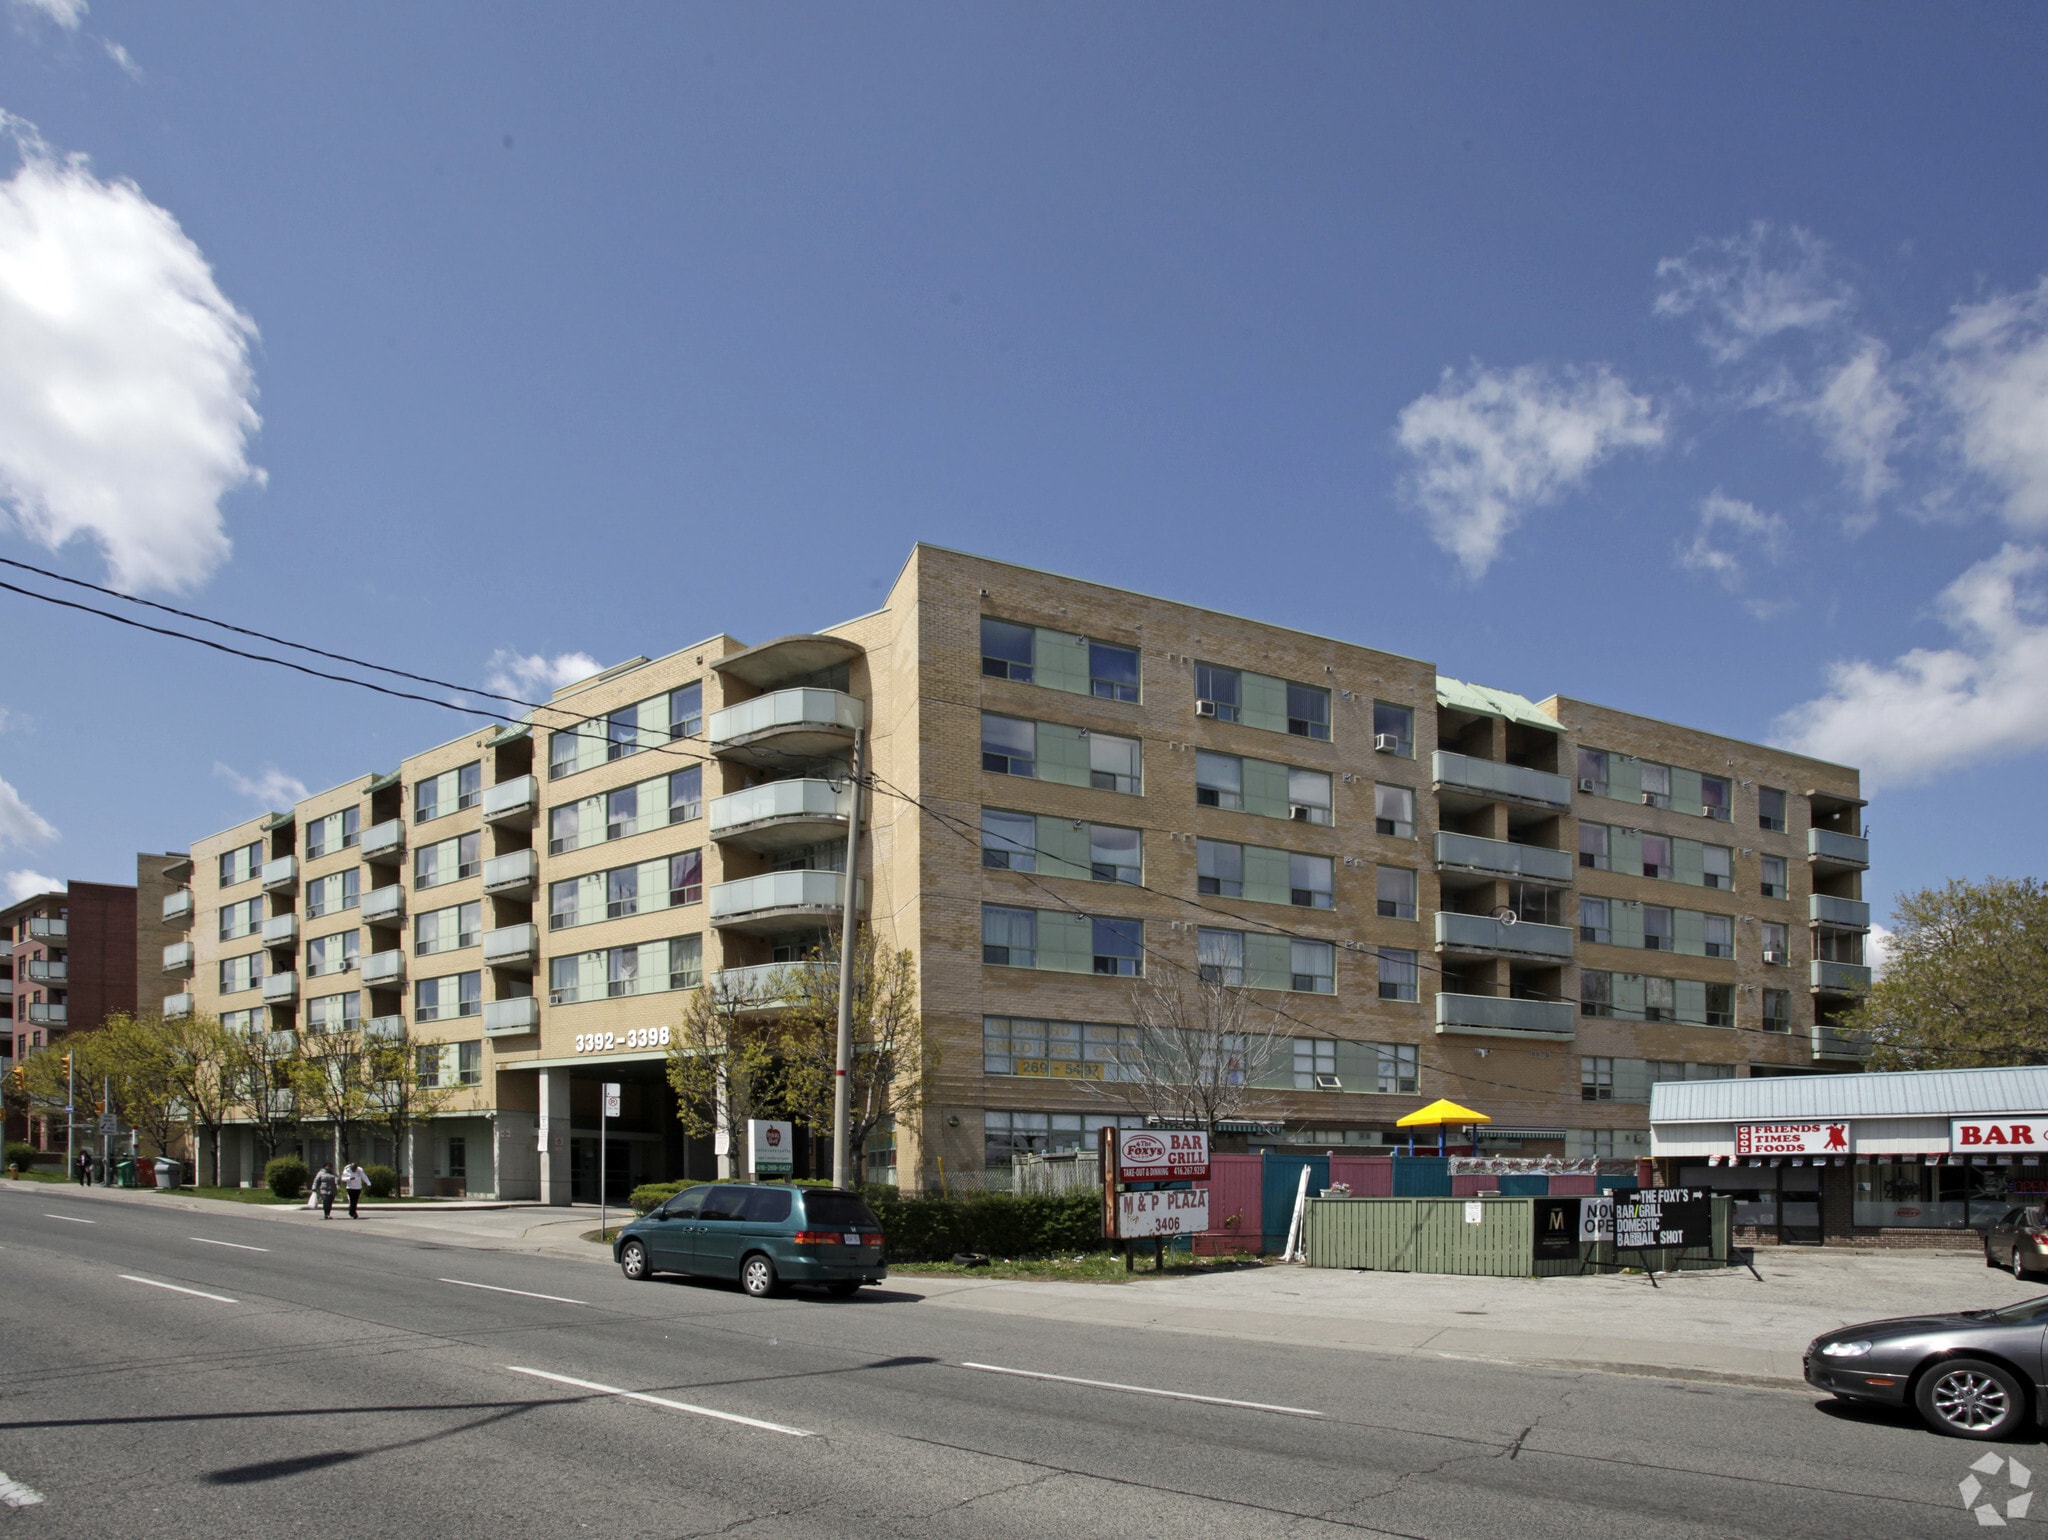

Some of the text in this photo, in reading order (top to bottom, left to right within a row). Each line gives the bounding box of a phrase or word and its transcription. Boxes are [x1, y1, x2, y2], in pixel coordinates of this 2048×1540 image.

[575, 1026, 671, 1053] 3392-3398
[1022, 1061, 1049, 1074] 269
[1755, 1124, 1821, 1134] FRIENDS
[1960, 1125, 2035, 1145] BAR
[1170, 1135, 1203, 1150] BAR
[1740, 1126, 1750, 1153] GOOD
[1755, 1134, 1801, 1143] TIMES
[1127, 1145, 1163, 1157] Foxys
[1755, 1144, 1805, 1152] FOODS
[1168, 1152, 1204, 1164] GRILL
[1123, 1168, 1145, 1177] TAKE-OUT
[2013, 1180, 2048, 1192] OPEN
[1124, 1191, 1206, 1213] M & P PLAZA
[1640, 1188, 1689, 1204] THE FOXY'S
[1587, 1204, 1613, 1218] NO
[1616, 1203, 1663, 1218] BAR/GRILL
[1155, 1217, 1180, 1232] 3406
[1585, 1220, 1613, 1233] OPE
[1617, 1218, 1660, 1232] DOMESTIC
[1660, 1230, 1683, 1244] SHOT
